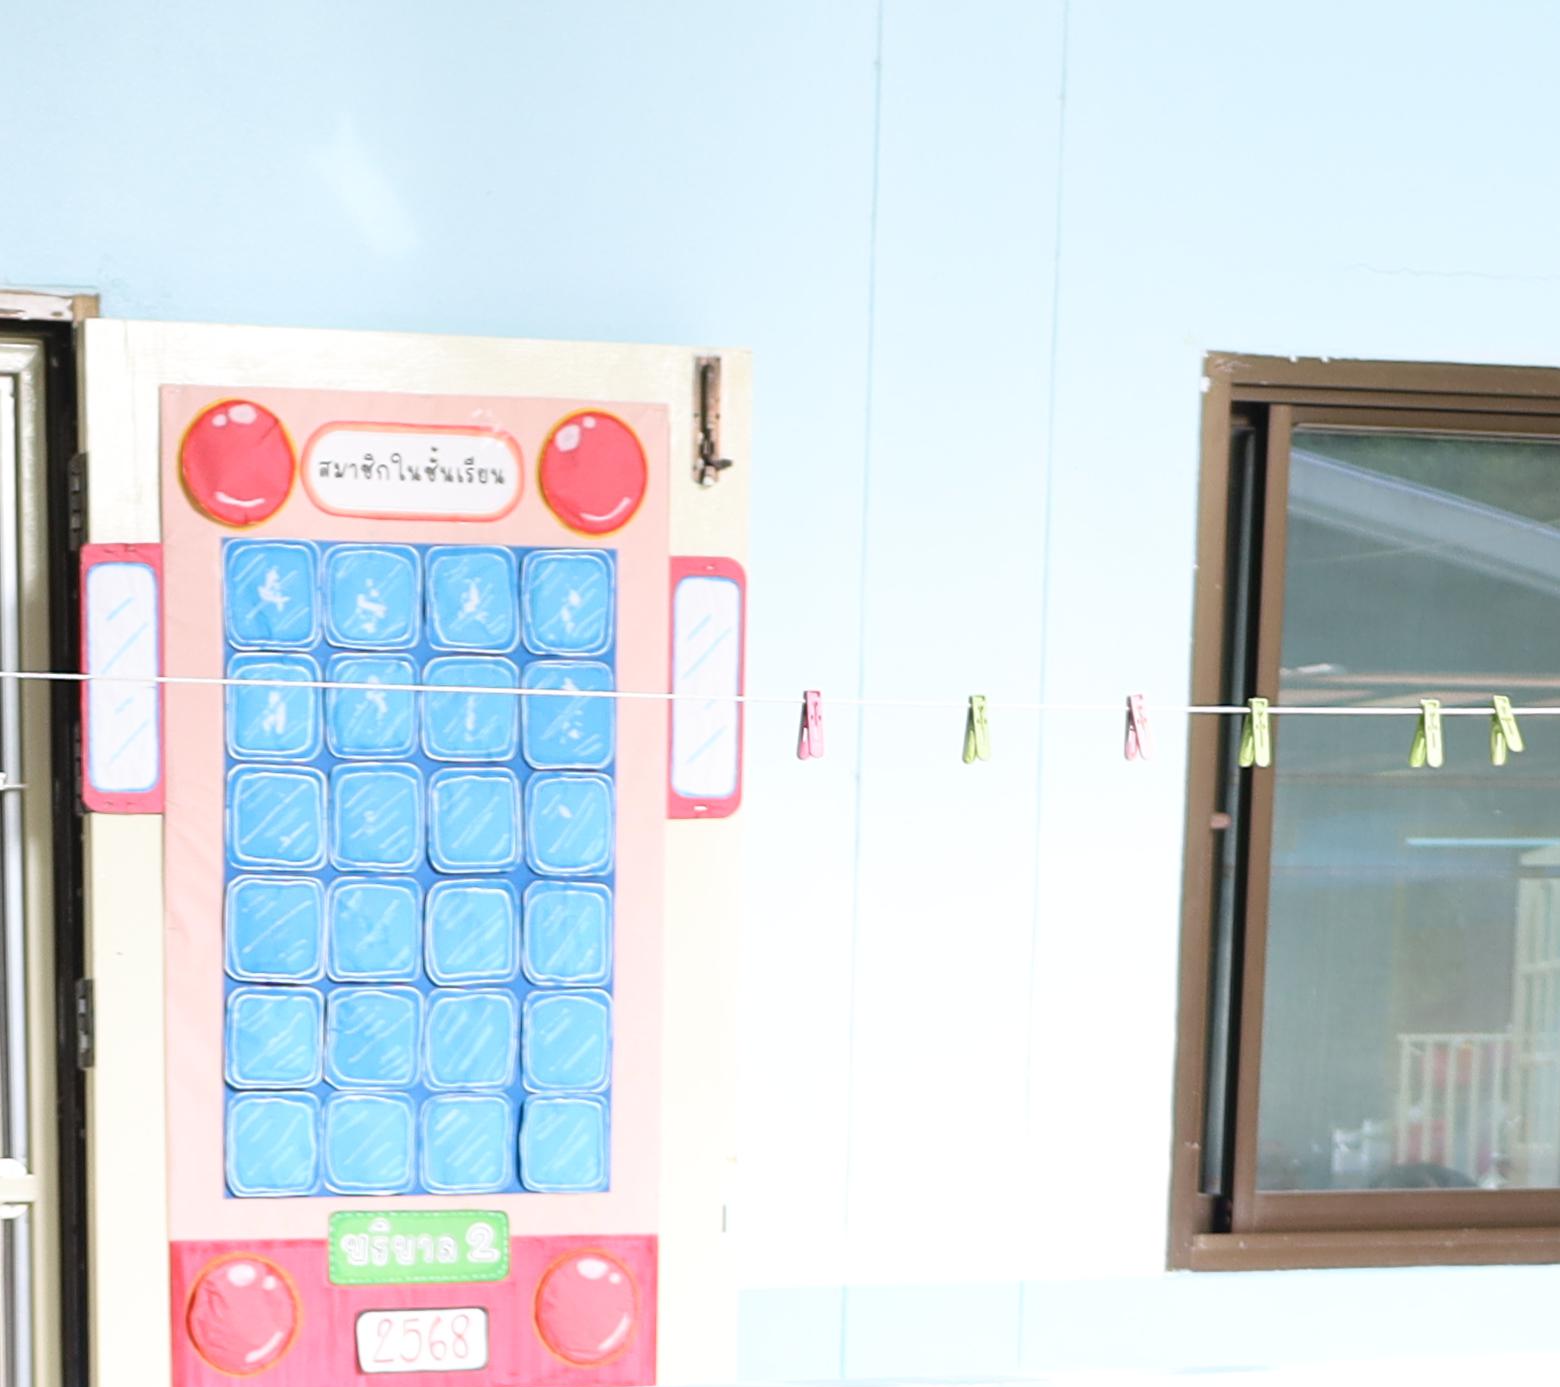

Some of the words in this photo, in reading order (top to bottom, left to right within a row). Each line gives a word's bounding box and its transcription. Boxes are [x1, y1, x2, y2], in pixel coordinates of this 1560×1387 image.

[319, 446, 505, 485] สมาชิกในชั้นเรียน
[465, 1222, 501, 1264] 2
[372, 1314, 470, 1364] 2568
